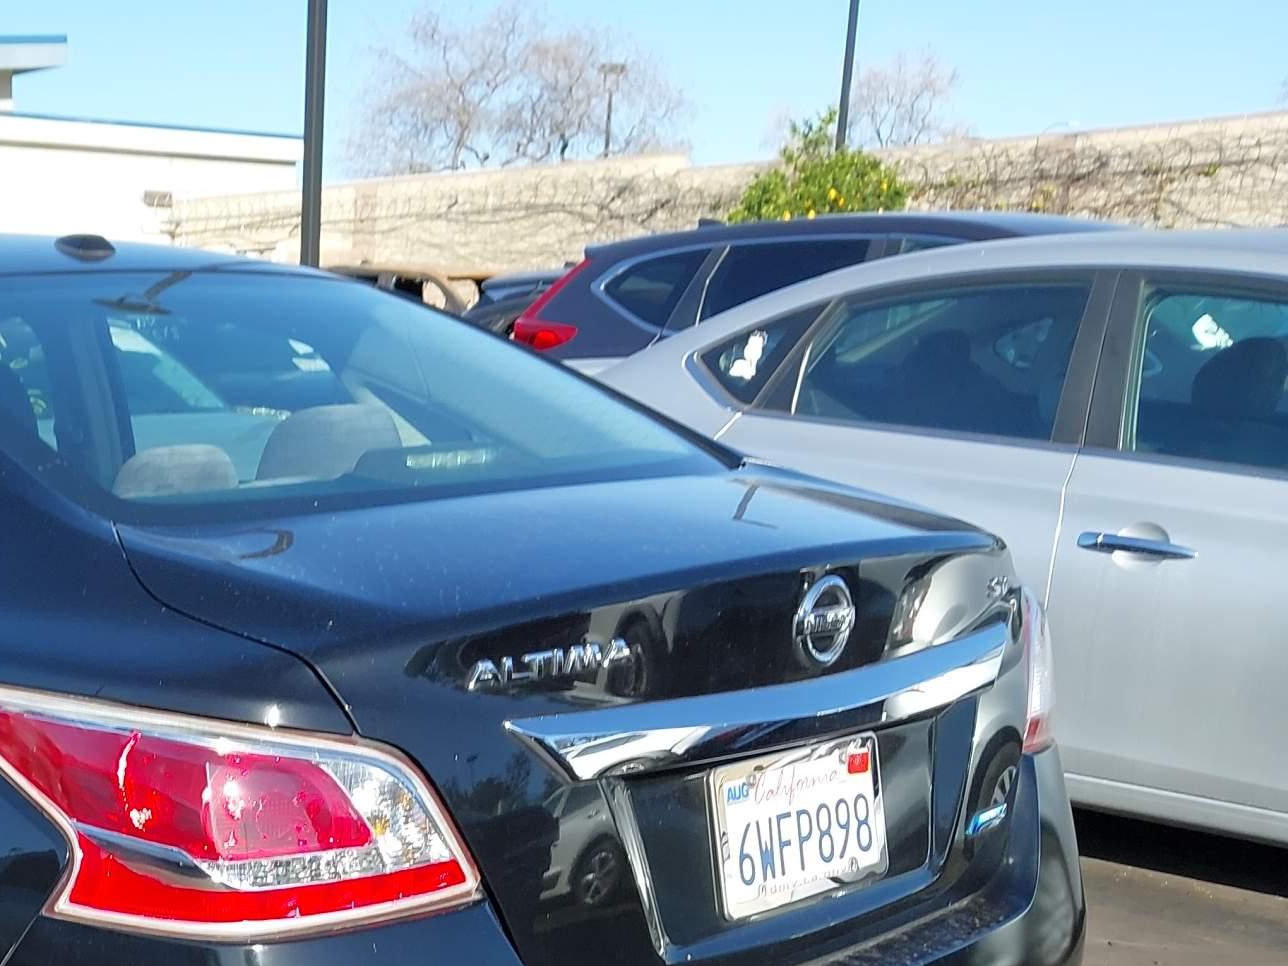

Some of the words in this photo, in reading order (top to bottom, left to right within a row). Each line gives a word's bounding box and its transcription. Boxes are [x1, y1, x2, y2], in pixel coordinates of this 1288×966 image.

[466, 637, 631, 690] ALTIMA
[726, 781, 750, 802] AUG
[753, 768, 838, 805] California
[738, 793, 873, 887] 6WFP898
